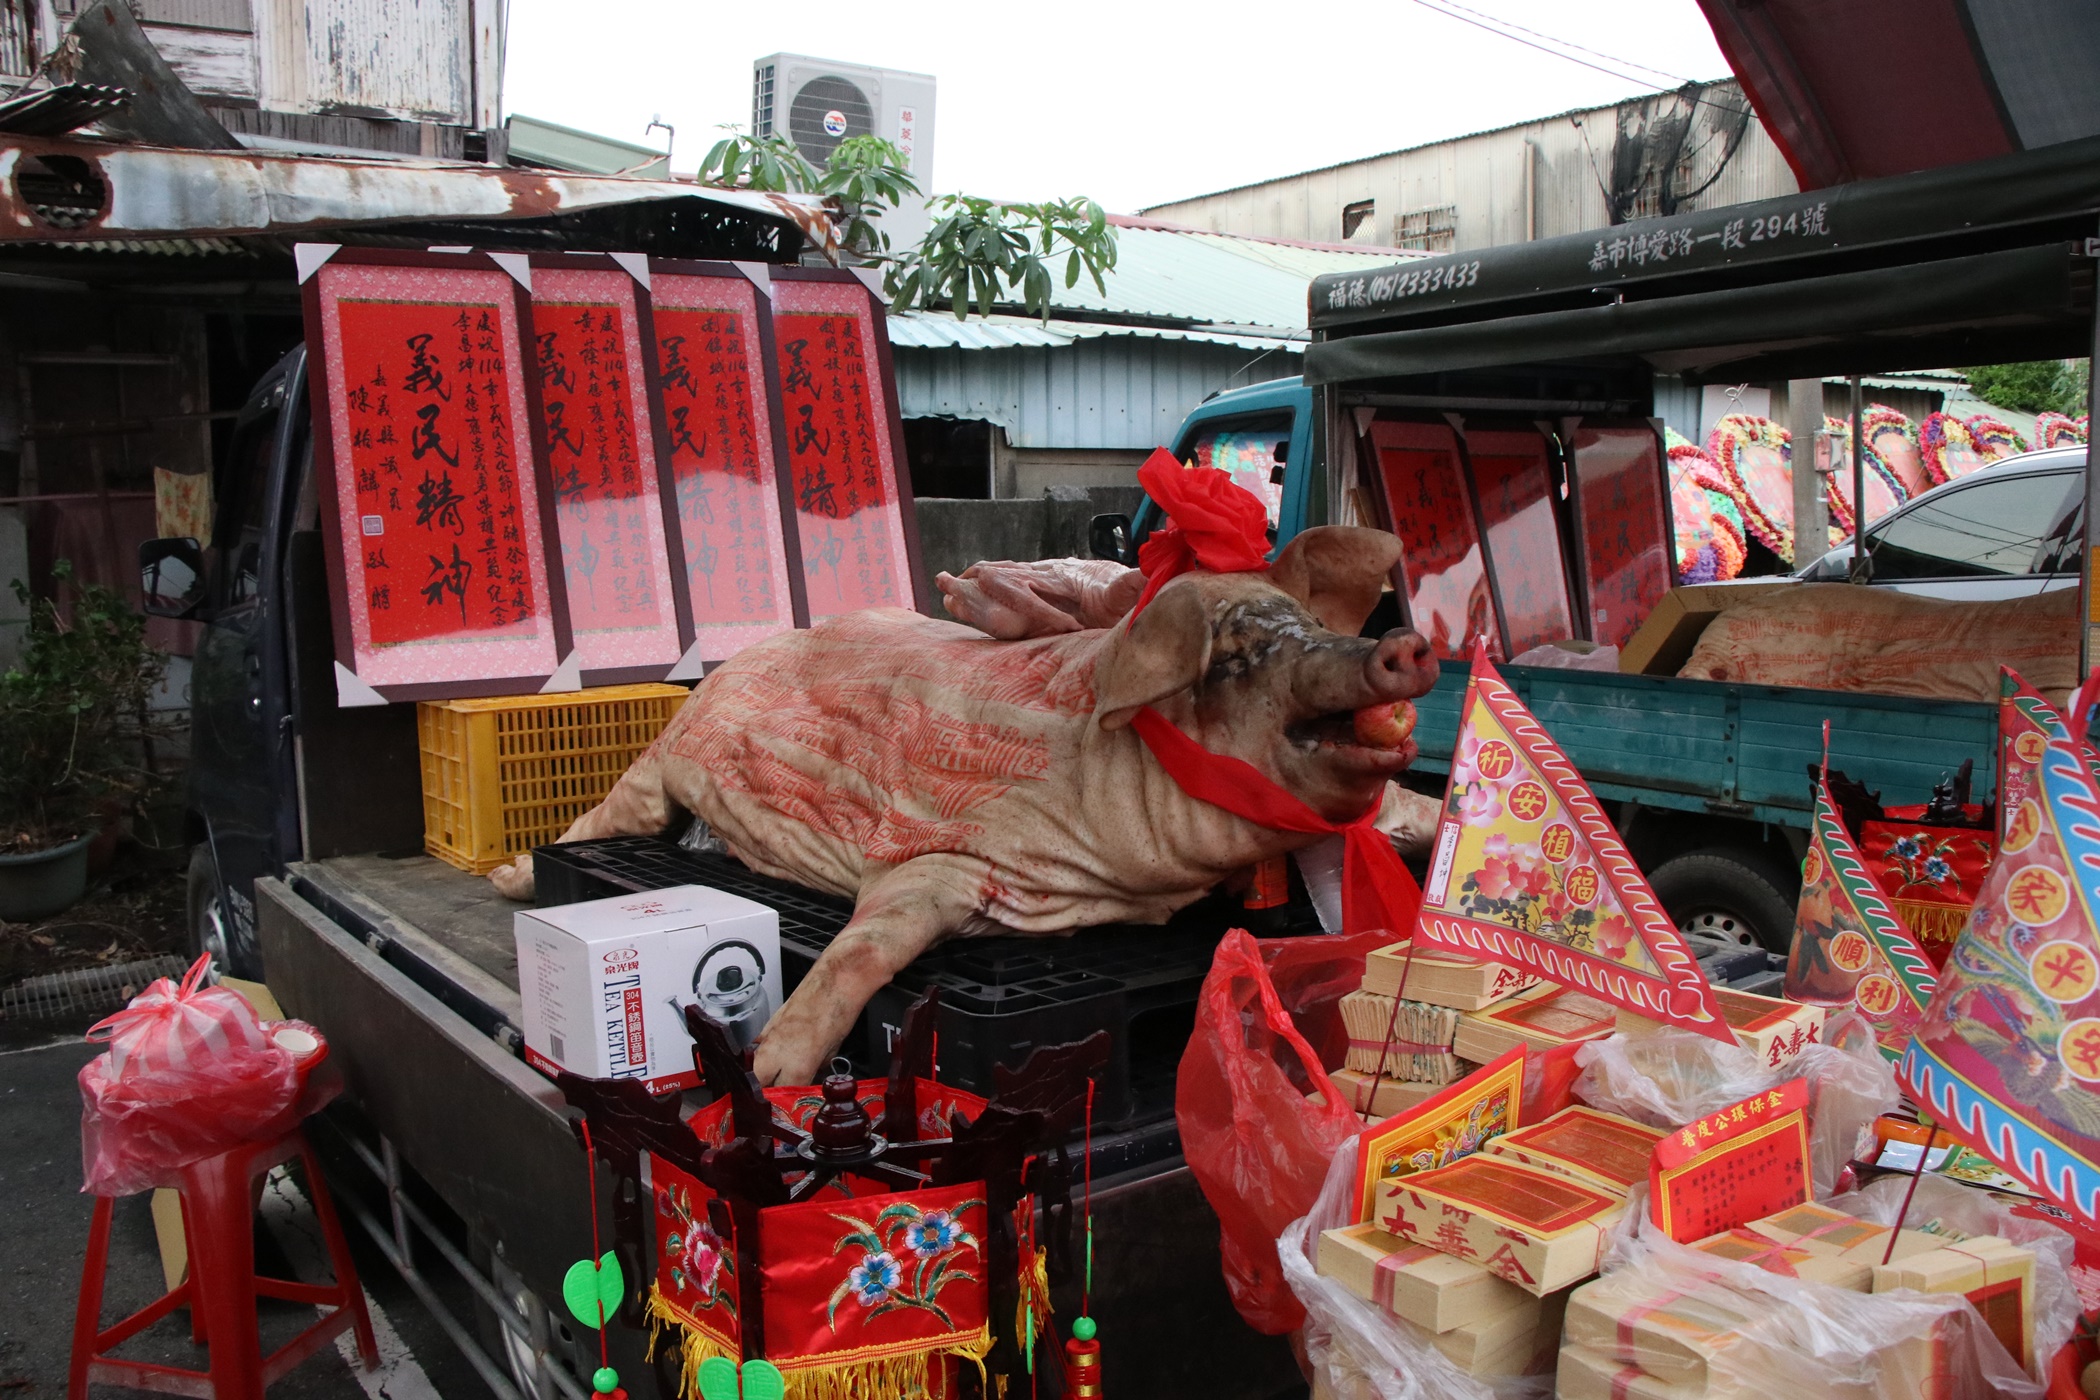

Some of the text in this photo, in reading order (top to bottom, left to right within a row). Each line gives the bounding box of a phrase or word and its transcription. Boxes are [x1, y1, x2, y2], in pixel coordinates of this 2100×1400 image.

[901, 111, 913, 173] 華菱冷
[1588, 202, 1830, 271] 嘉市博愛路一段294號
[371, 363, 402, 512] 嘉義縣議員
[402, 333, 472, 627] 義民精神
[784, 339, 844, 602] 義民精神
[1480, 743, 1595, 902] 祈安植福
[605, 961, 639, 975] 泉光牌
[604, 974, 648, 1079] TEA KETTLE
[1682, 1091, 1784, 1148] 普度公環保金
